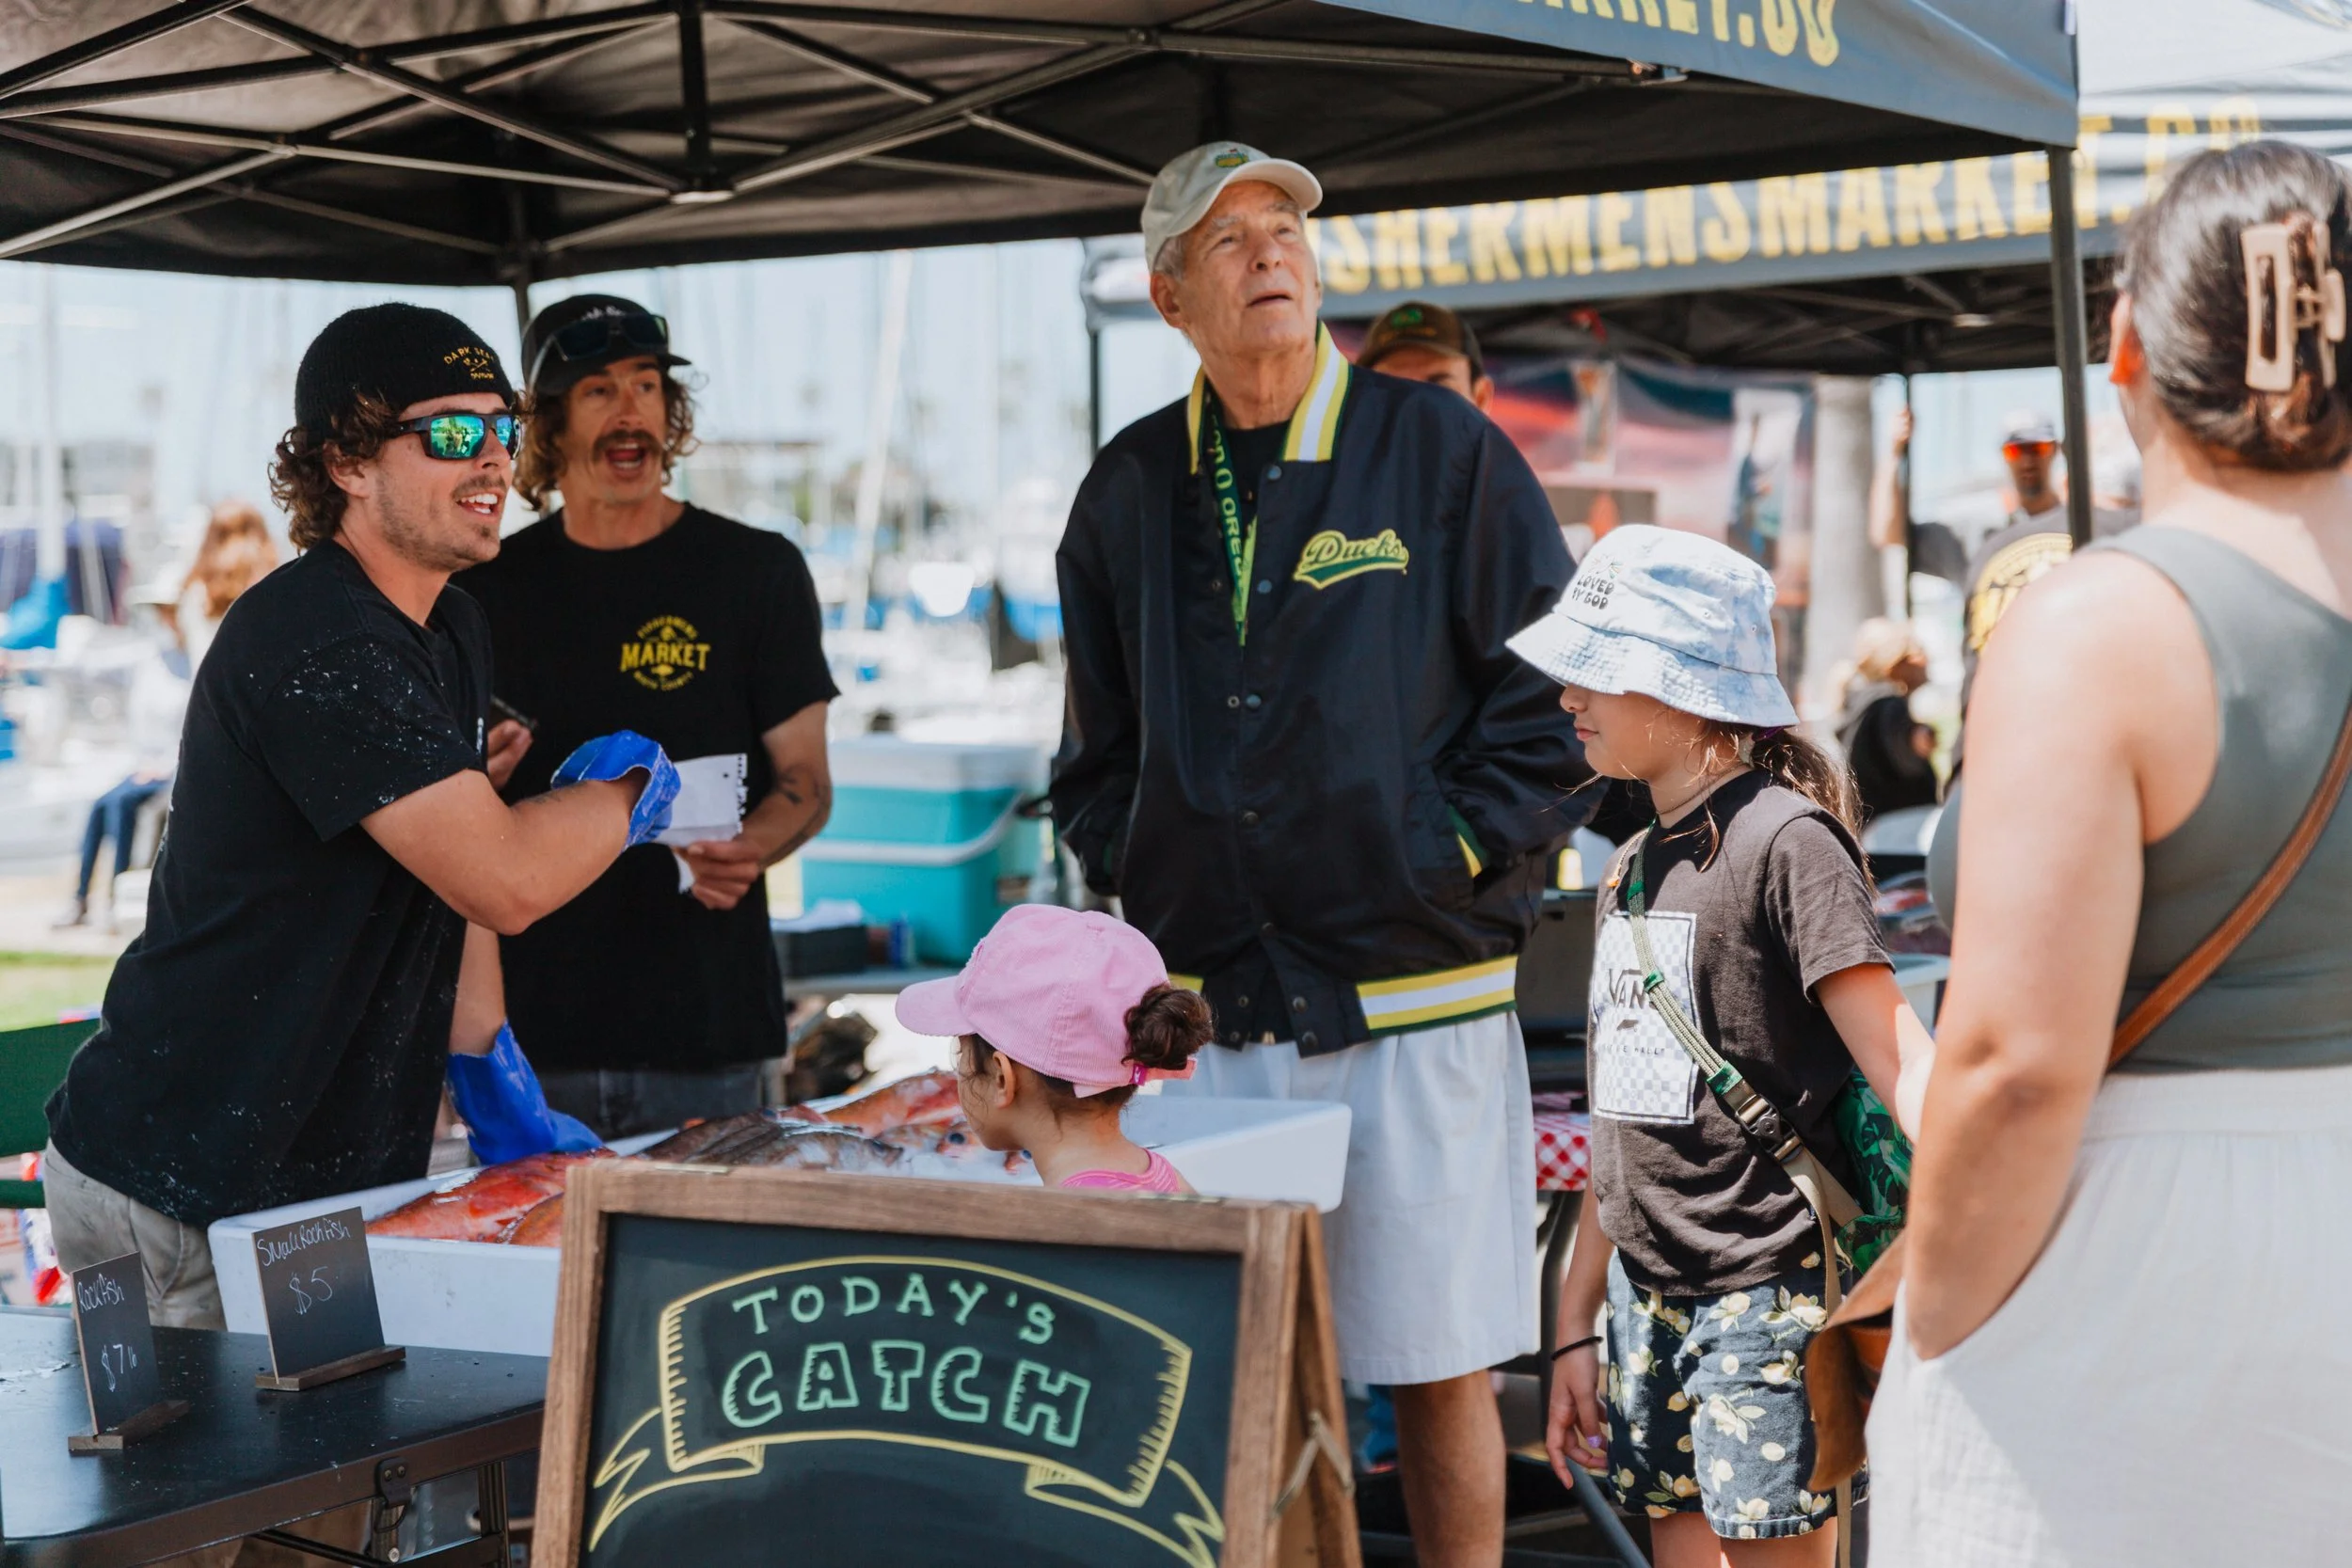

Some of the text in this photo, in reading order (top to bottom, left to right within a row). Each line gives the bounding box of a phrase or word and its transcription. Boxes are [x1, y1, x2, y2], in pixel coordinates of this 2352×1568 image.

[443, 346, 470, 365] DARK
[1301, 530, 1405, 566] Ducks
[1577, 574, 1615, 595] LOVED
[1583, 592, 1609, 610] GOD
[620, 641, 711, 673] MARKET
[288, 1265, 333, 1316] $5
[731, 1273, 1056, 1344] TODAY'S
[101, 1343, 124, 1393] $7
[722, 1338, 1091, 1449] CATCH
